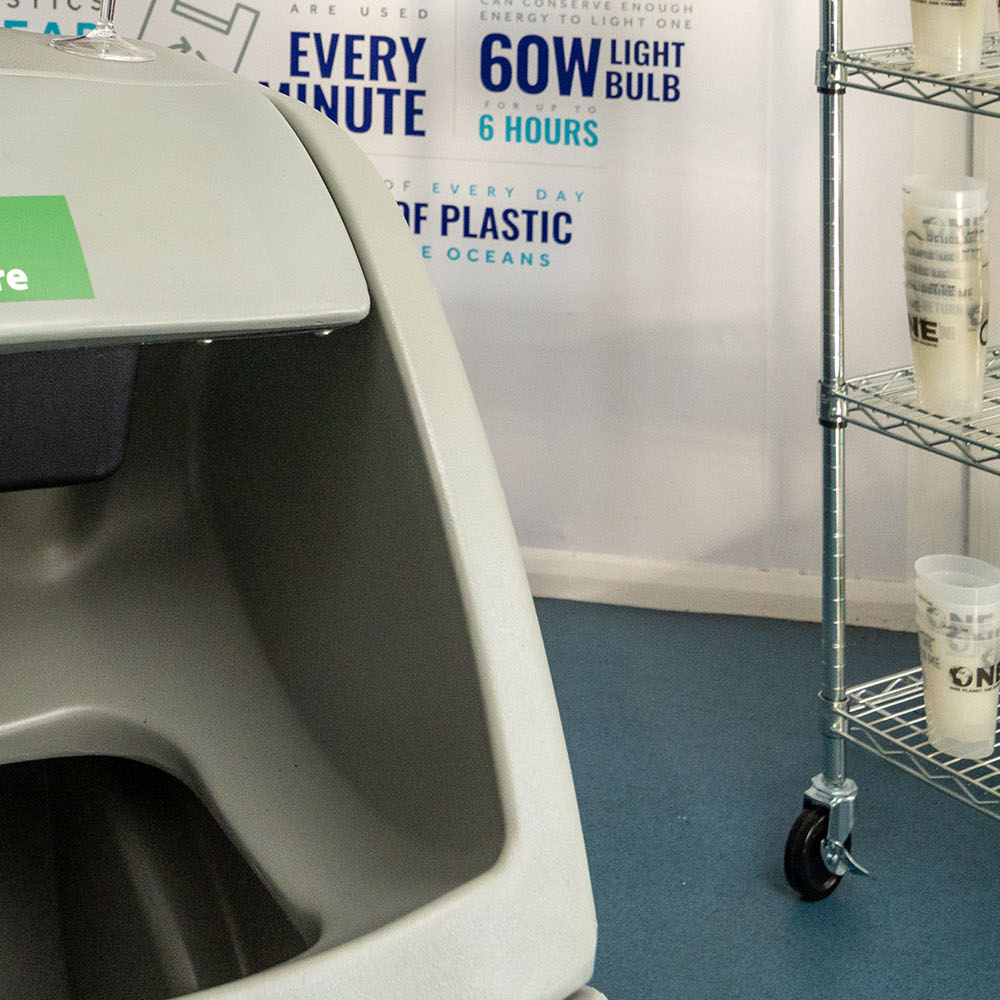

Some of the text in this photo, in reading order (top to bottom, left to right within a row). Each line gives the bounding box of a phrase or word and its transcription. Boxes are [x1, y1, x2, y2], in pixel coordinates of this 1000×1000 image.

[289, 3, 429, 20] ARE USED
[620, 1, 693, 14] ENOUGH
[479, 10, 692, 31] ENERGY TO LIGHT ONE
[289, 31, 428, 83] EVERY
[479, 32, 602, 98] 60W
[610, 38, 686, 68] LIGHT
[605, 70, 681, 103] BULB
[484, 100, 597, 115] FOR UP TO
[479, 113, 599, 148] 6 HOURS
[432, 182, 515, 199] EVERY
[536, 188, 584, 203] DAY
[440, 204, 573, 245] PLASTIC
[446, 247, 550, 268] OCEANS
